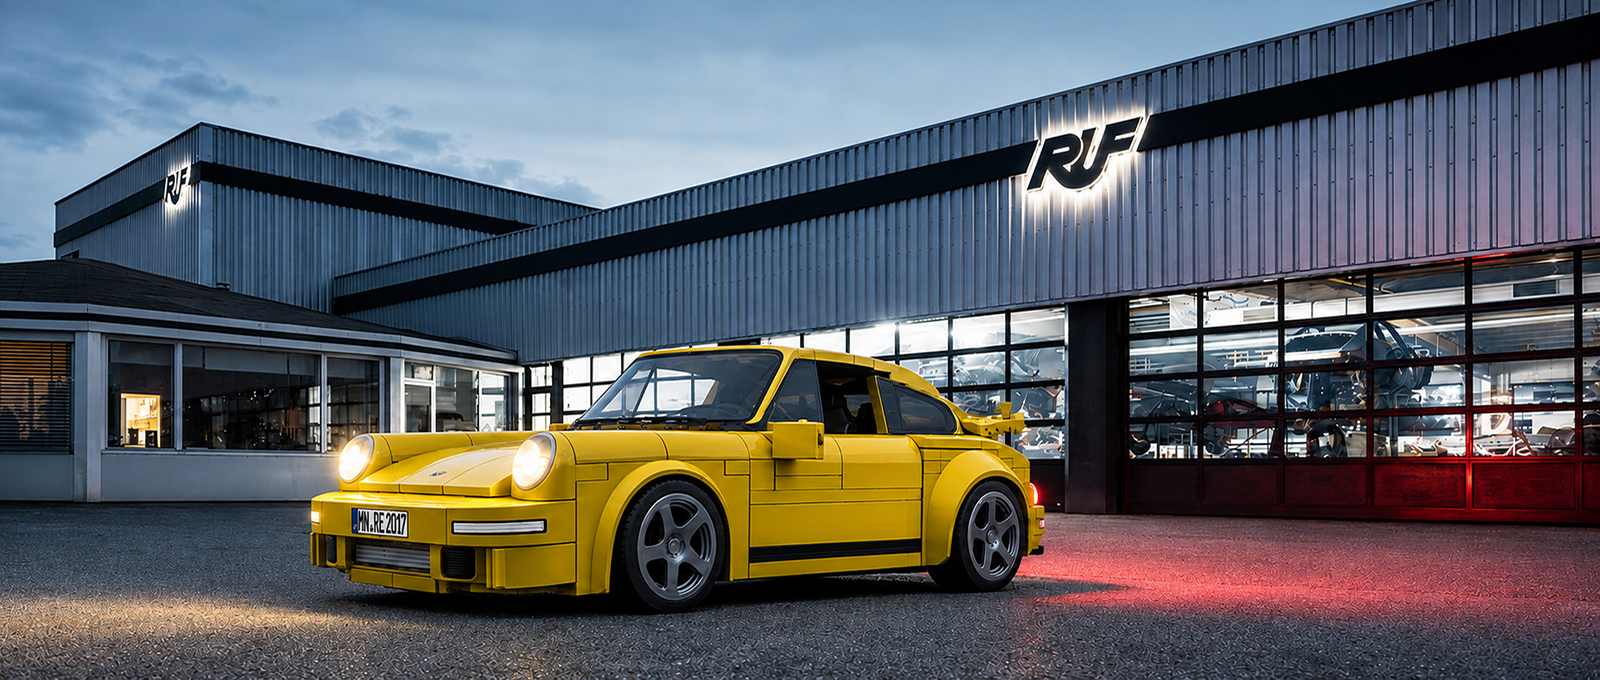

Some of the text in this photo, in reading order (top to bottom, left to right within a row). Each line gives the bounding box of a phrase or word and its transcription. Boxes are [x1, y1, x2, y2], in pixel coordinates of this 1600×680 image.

[1026, 116, 1142, 191] RUF
[165, 166, 188, 205] RUF
[373, 511, 385, 534] RE
[386, 512, 407, 535] 2017
